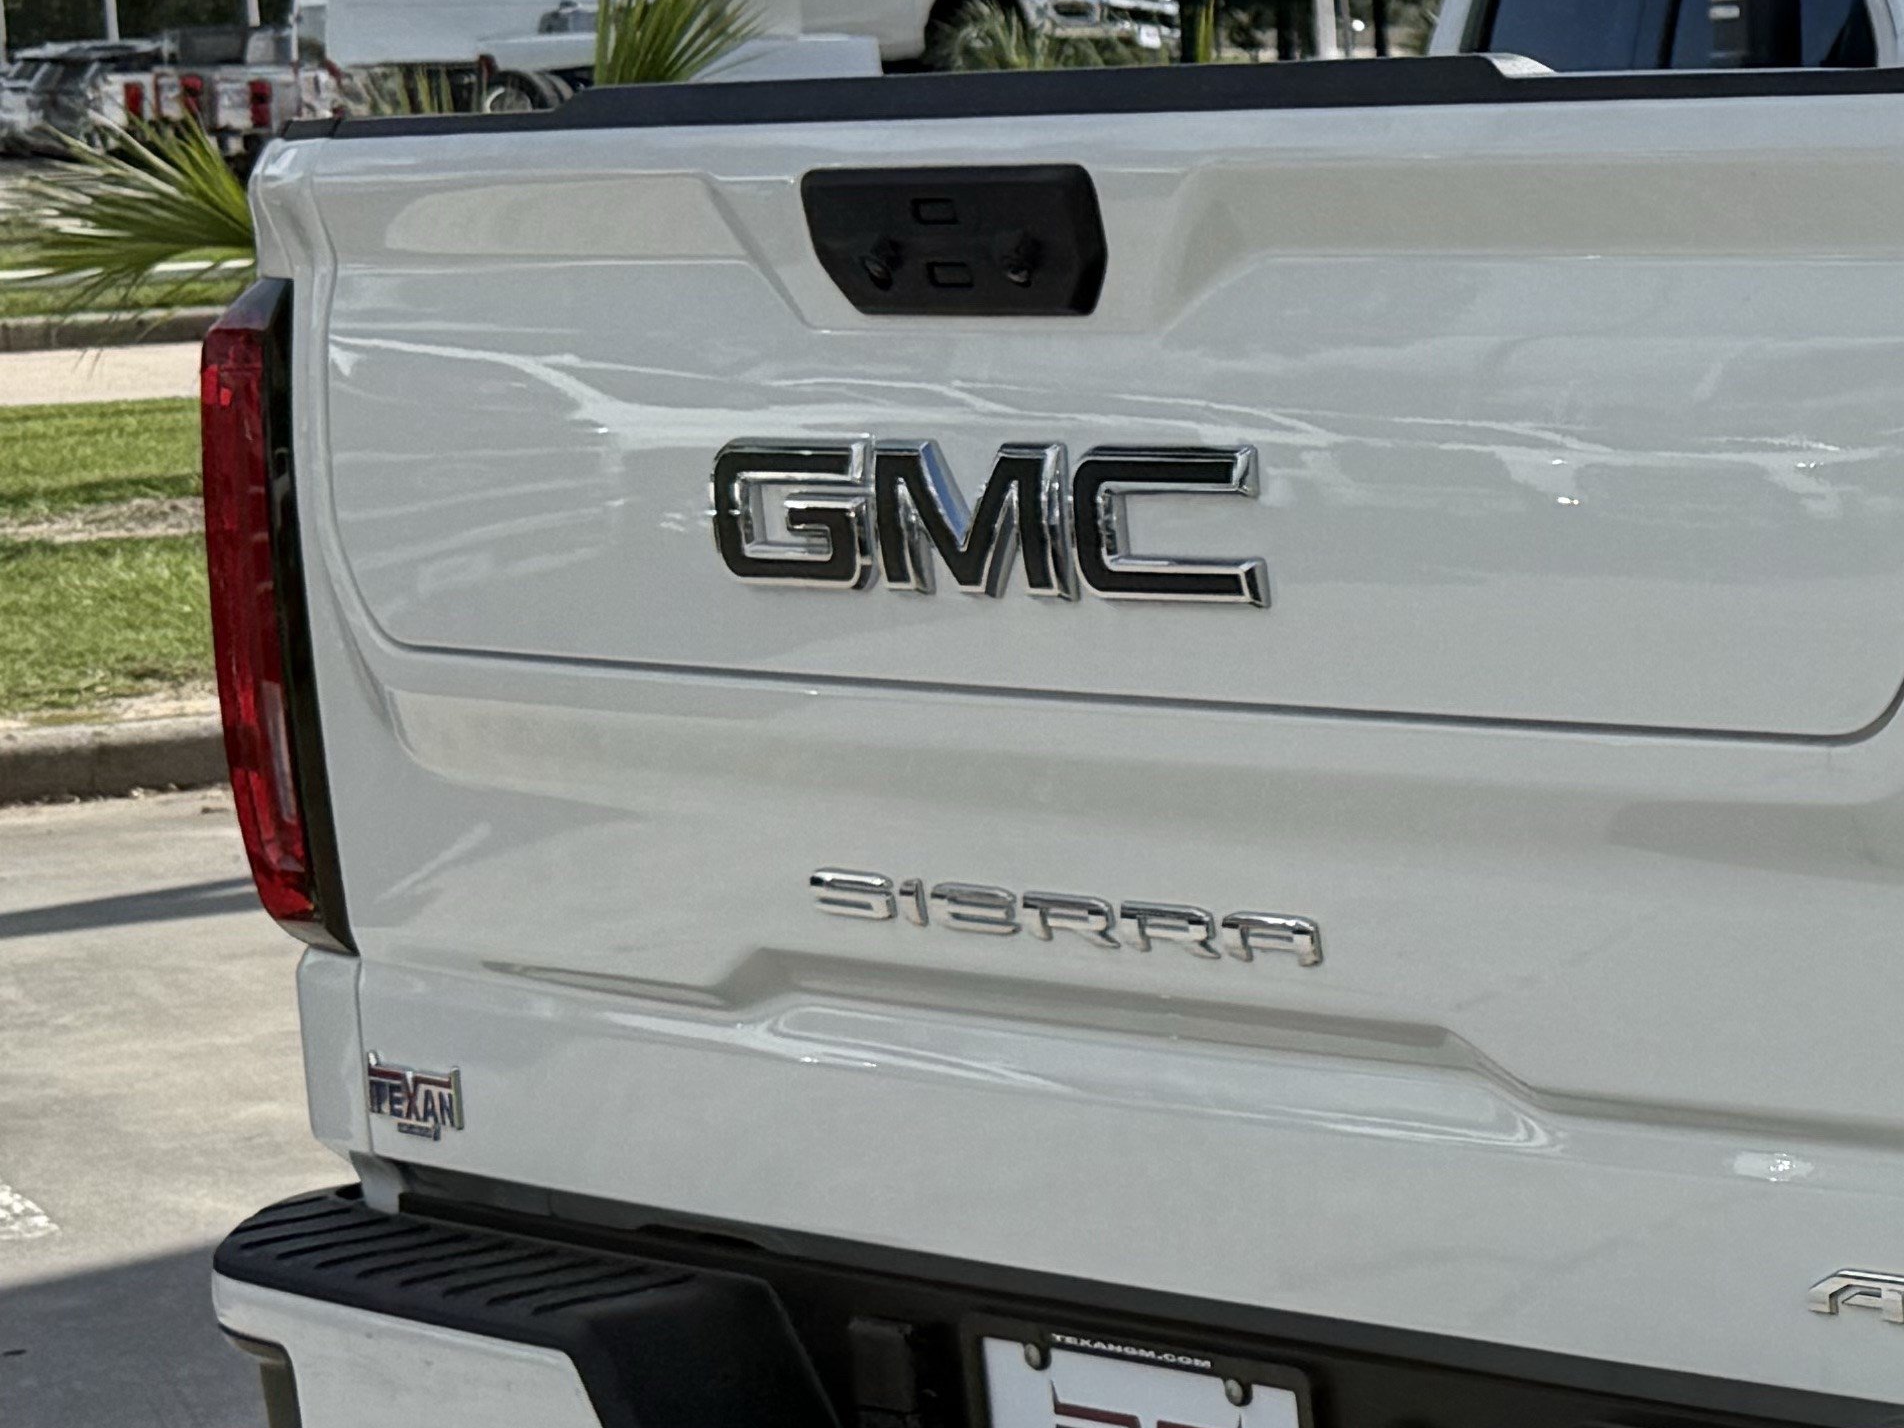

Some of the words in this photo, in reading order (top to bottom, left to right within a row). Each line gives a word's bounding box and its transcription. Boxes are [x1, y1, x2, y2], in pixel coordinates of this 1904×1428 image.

[707, 432, 1272, 609] GMC
[808, 867, 1324, 967] SIERRA
[368, 1068, 457, 1129] TEXAN
[1051, 1333, 1213, 1370] TEXANGM.COM
